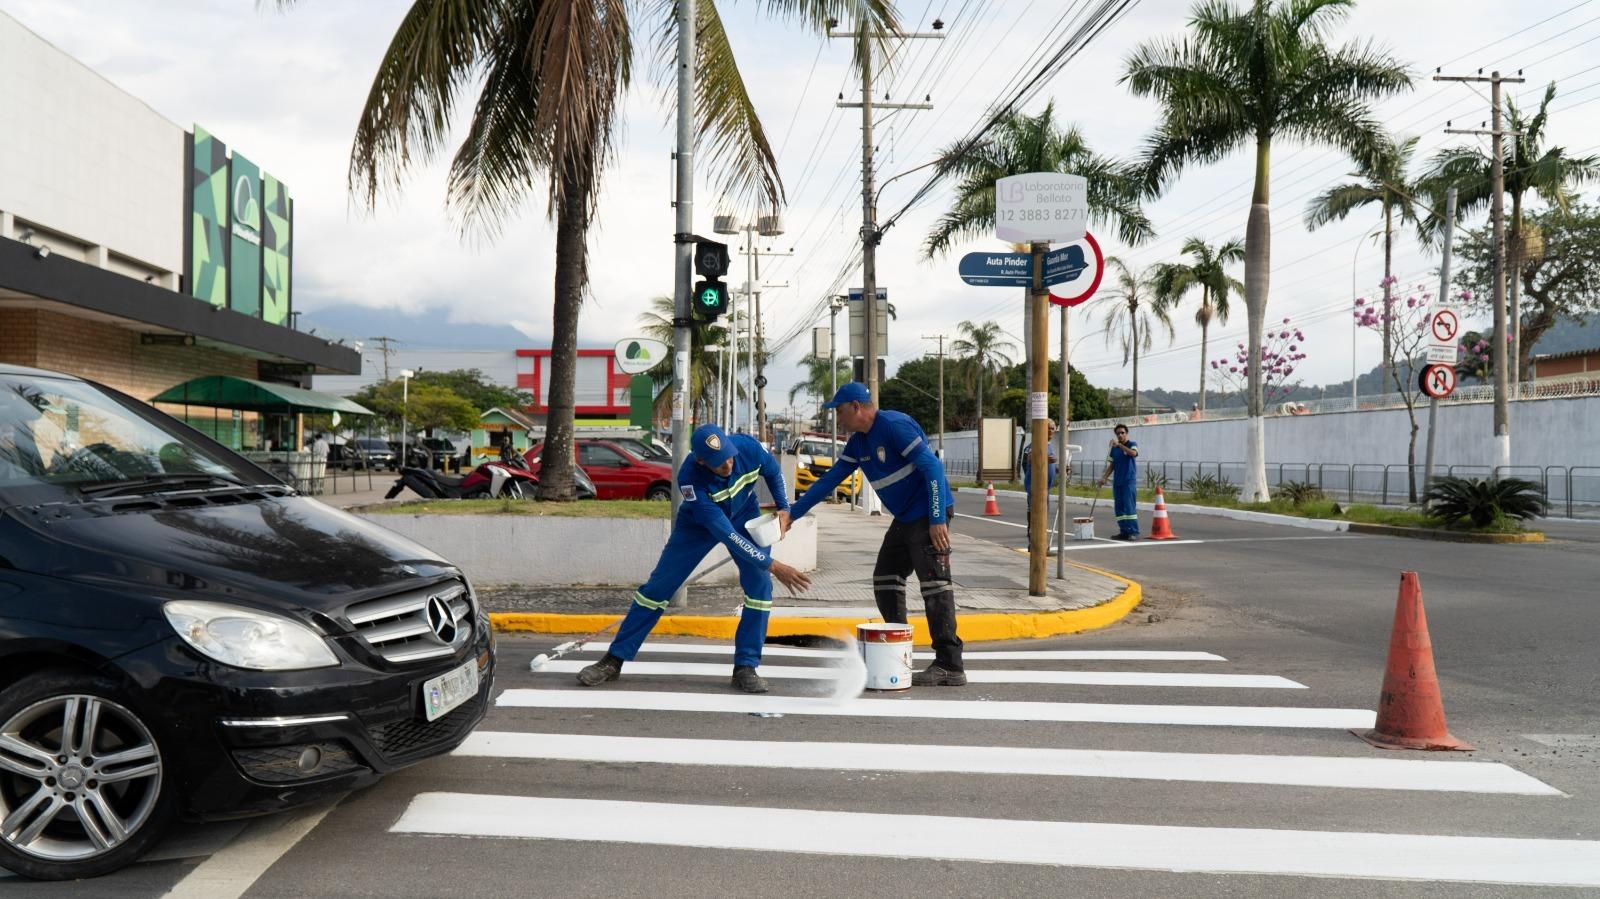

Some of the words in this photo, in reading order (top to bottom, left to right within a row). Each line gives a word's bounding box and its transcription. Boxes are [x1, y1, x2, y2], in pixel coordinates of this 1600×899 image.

[1037, 193, 1072, 204] Bellato
[1001, 210, 1014, 221] 12
[1020, 209, 1050, 221] 3883
[1055, 208, 1084, 221] 8271
[986, 257, 1002, 266] Auta
[1004, 257, 1027, 266] Pinder
